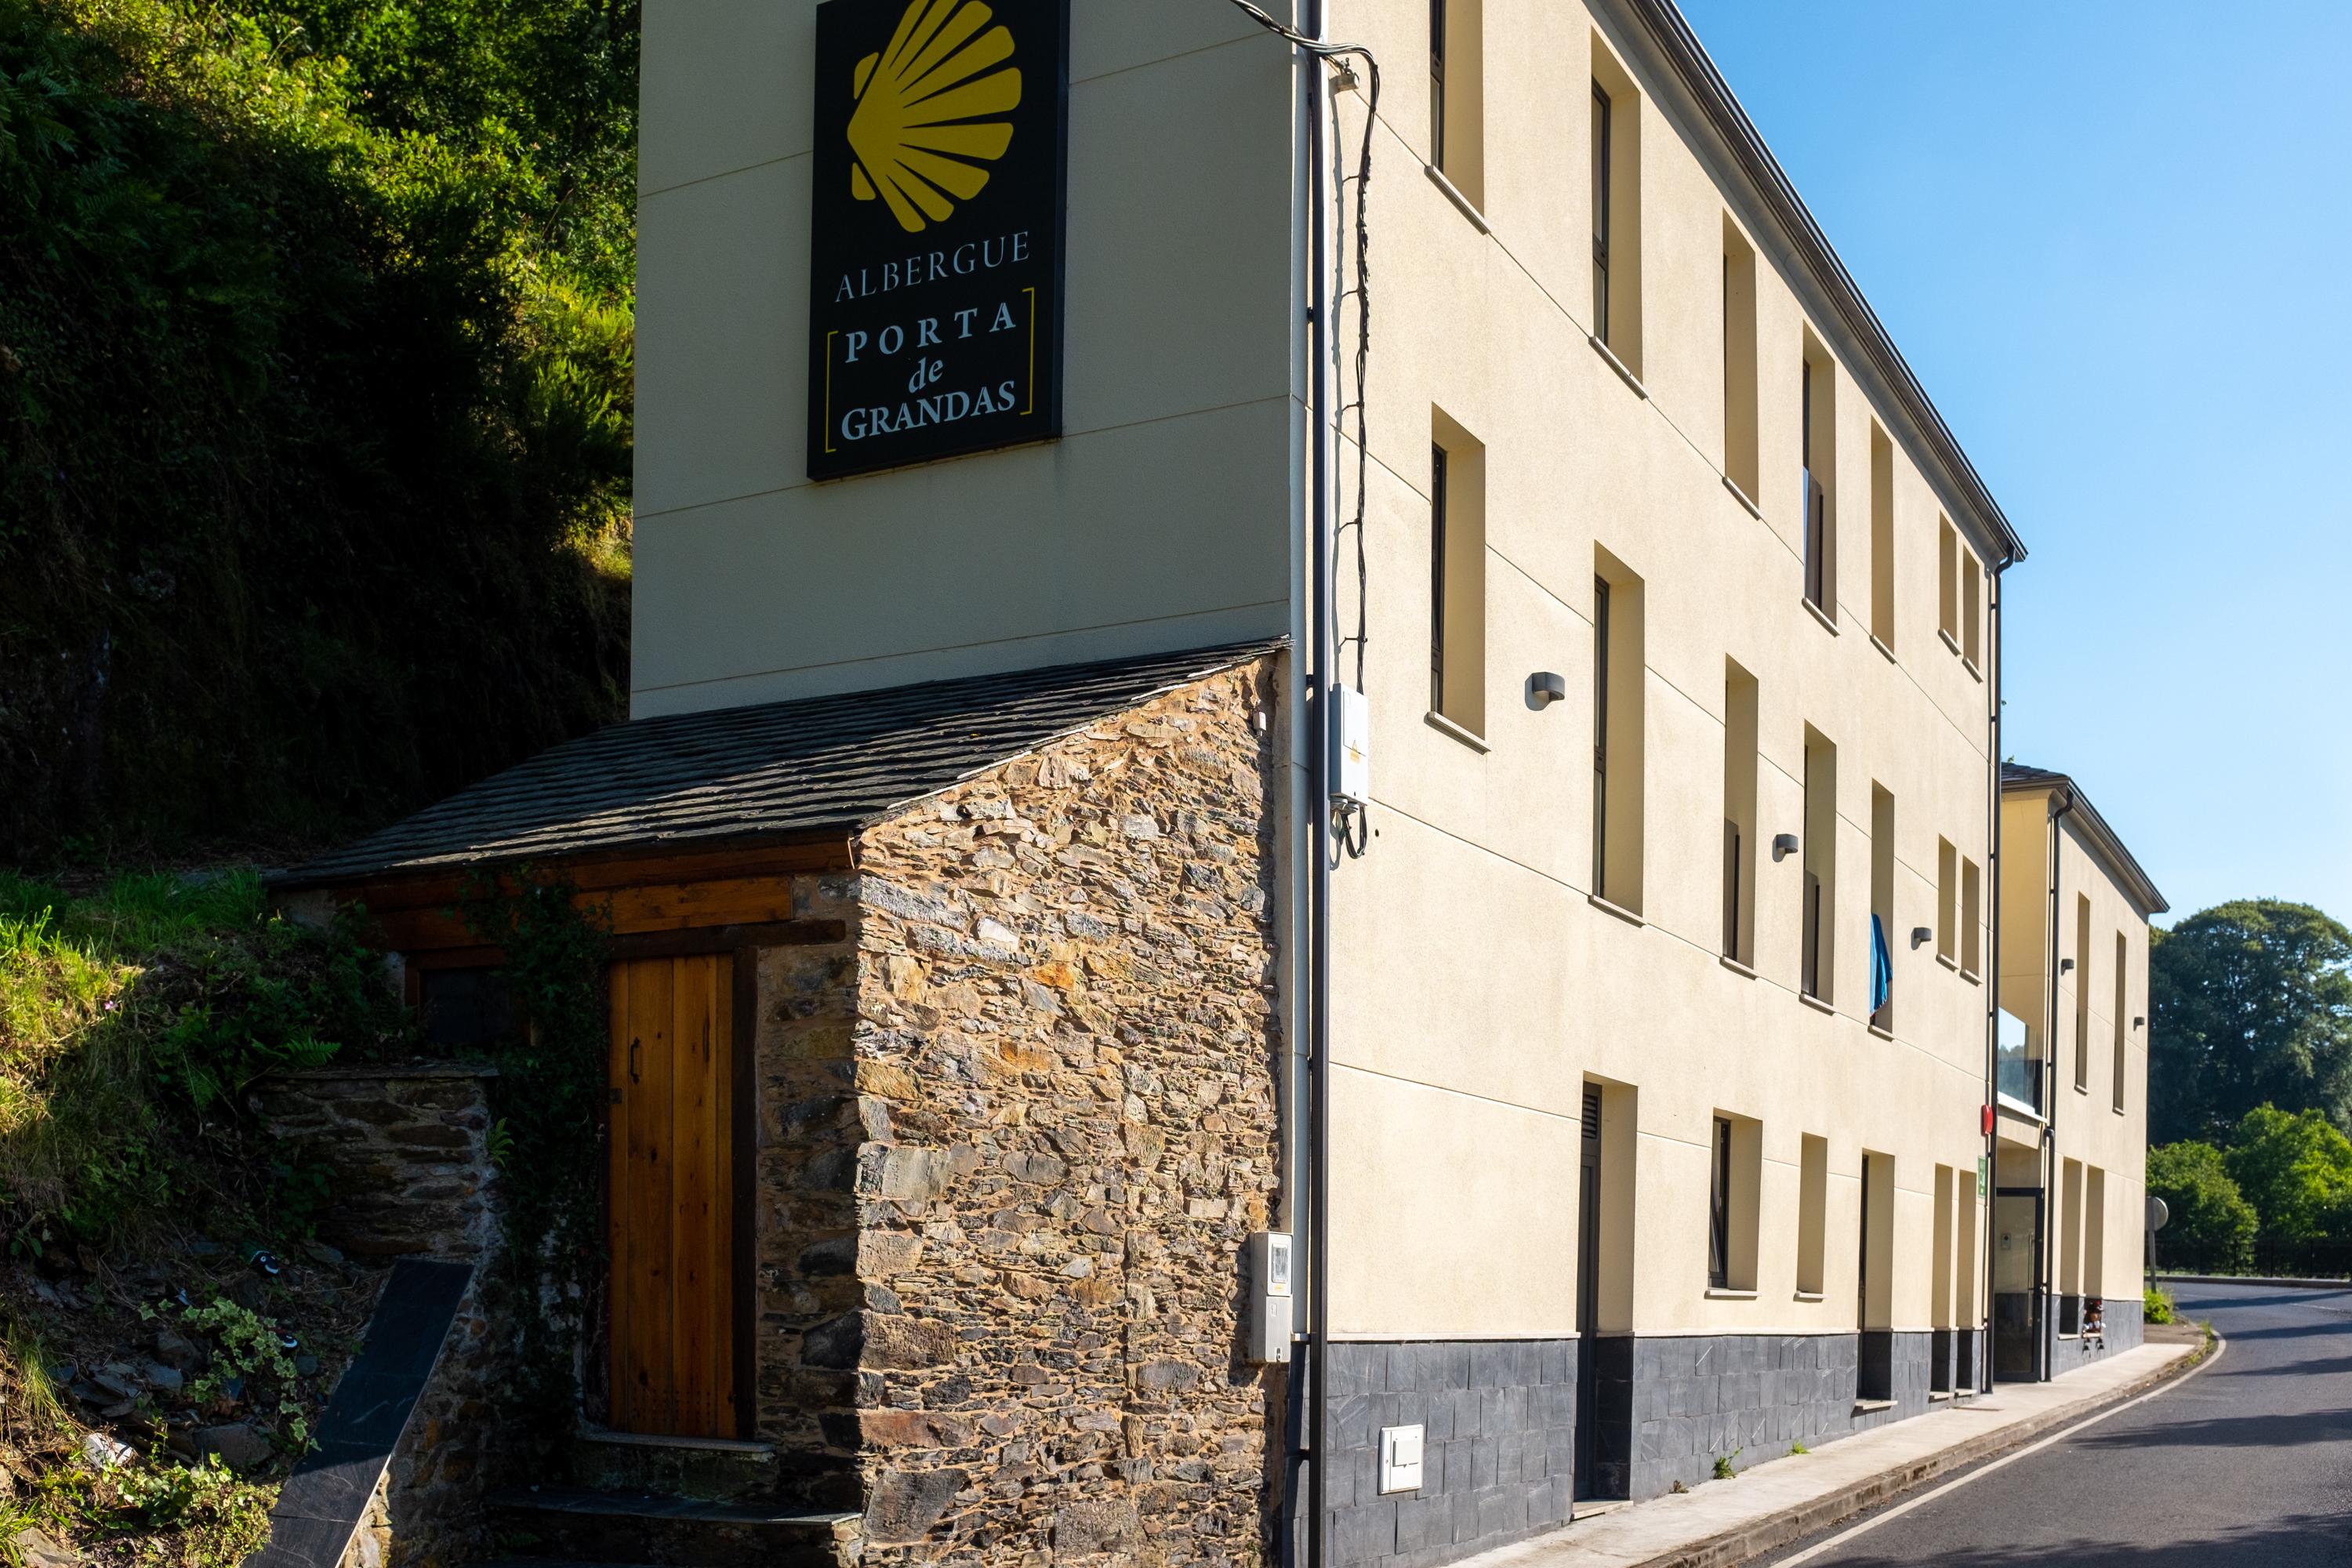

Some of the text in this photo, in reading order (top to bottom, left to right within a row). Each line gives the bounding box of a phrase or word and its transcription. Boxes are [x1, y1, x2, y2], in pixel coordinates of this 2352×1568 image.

[835, 231, 1029, 303] ALBERGUE
[844, 302, 1017, 364] PORTA
[908, 357, 944, 394] de
[841, 380, 1016, 441] GRANDAS
